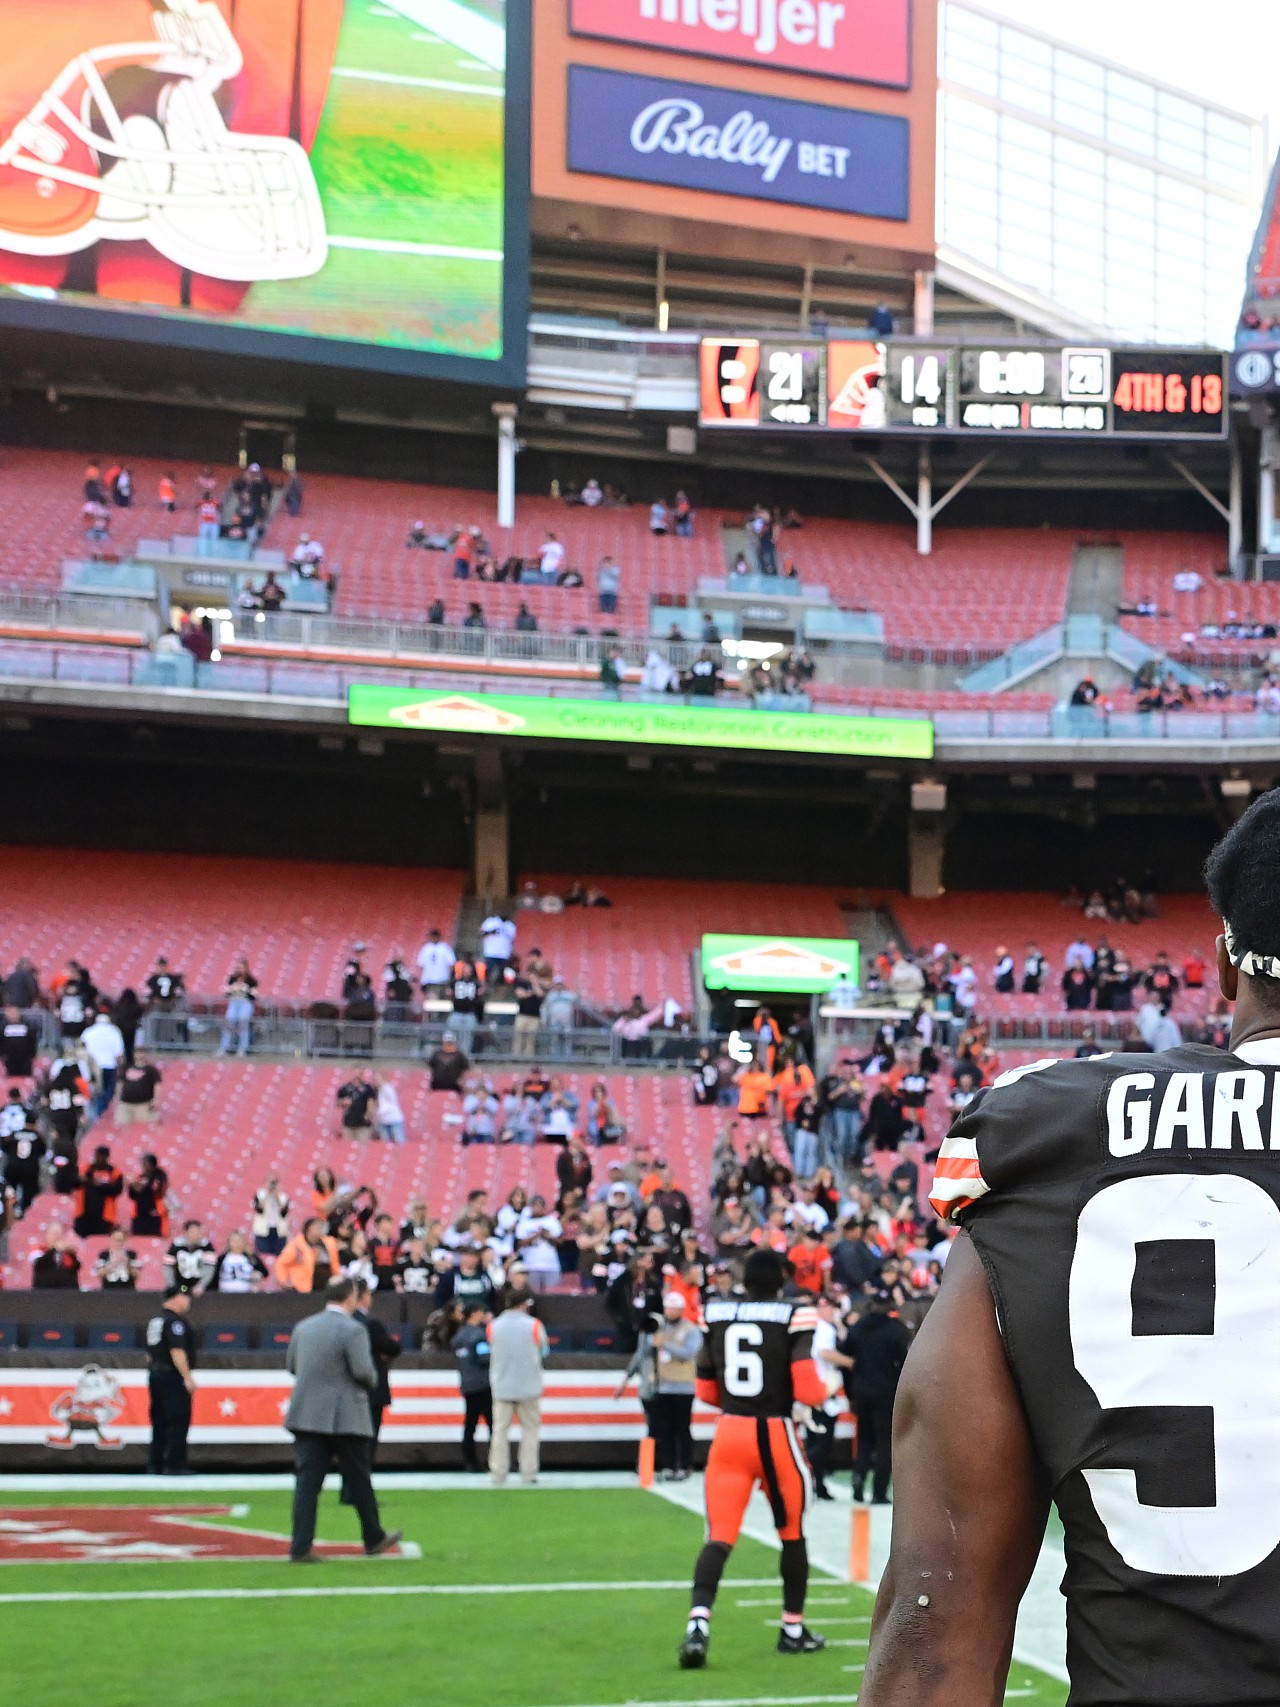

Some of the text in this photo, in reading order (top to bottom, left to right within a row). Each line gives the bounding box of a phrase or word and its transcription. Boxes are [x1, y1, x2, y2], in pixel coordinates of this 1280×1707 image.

[629, 98, 851, 183] Bally BET
[768, 351, 803, 401] 21
[901, 355, 941, 404] 14
[1113, 371, 1222, 415] 4TH & 13
[558, 708, 646, 732] Cleaning
[653, 714, 767, 738] Restoration
[723, 1321, 764, 1398] 6
